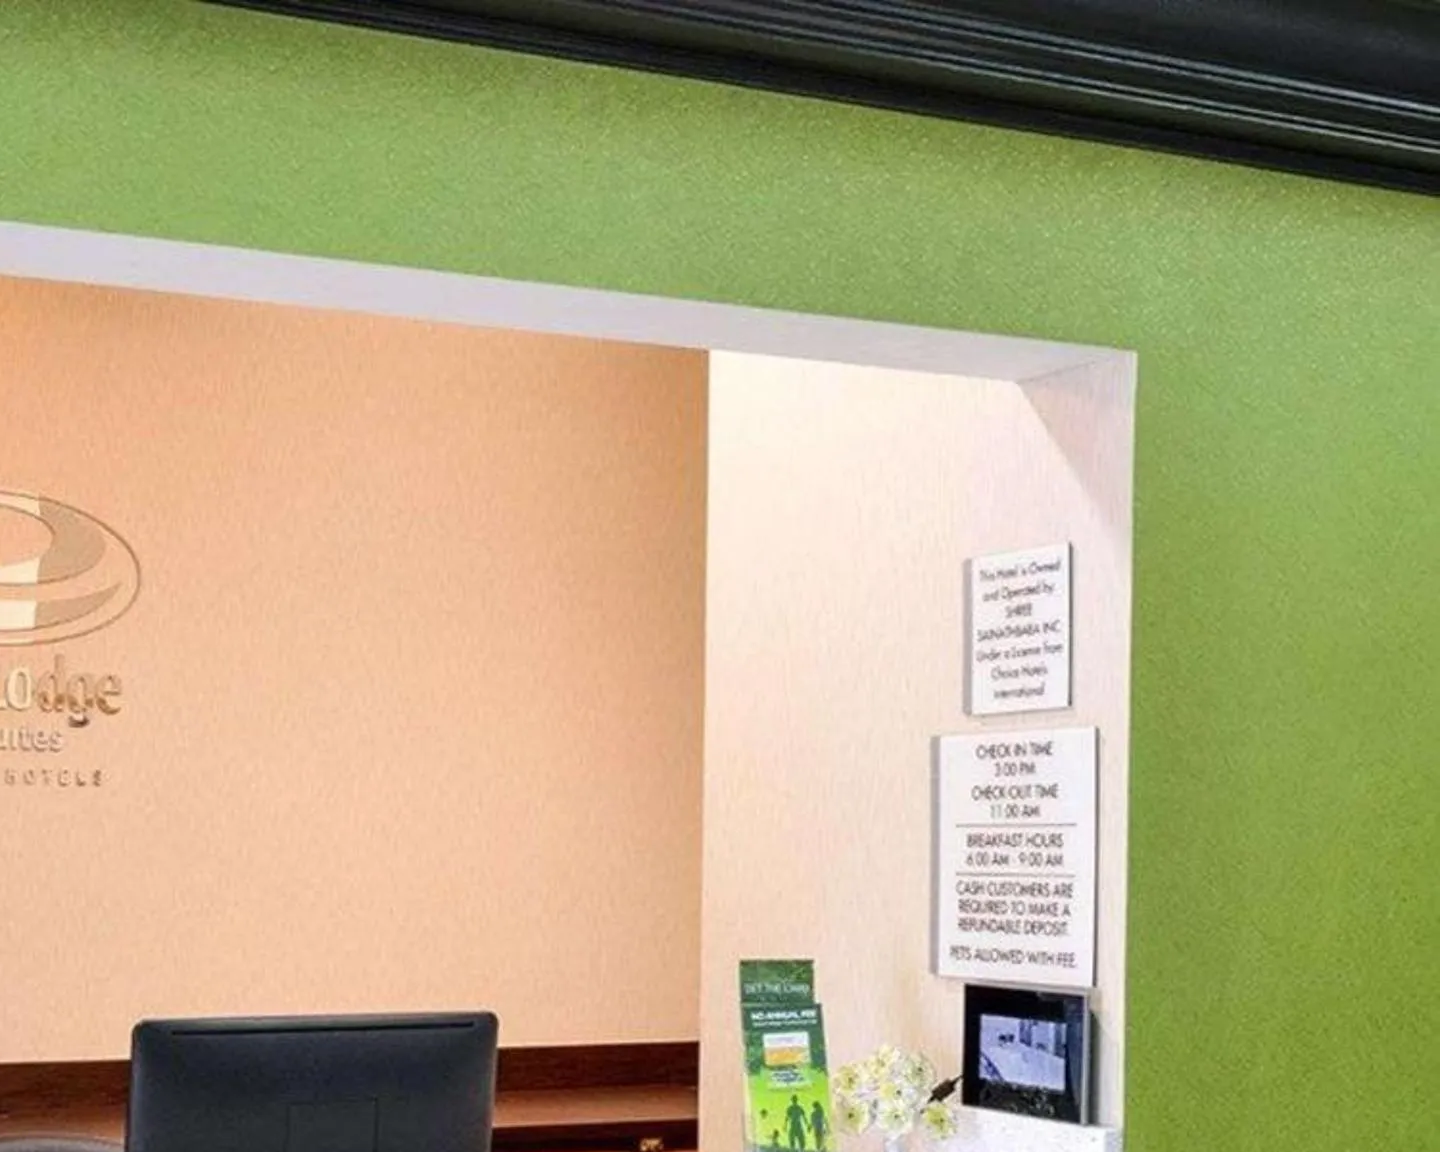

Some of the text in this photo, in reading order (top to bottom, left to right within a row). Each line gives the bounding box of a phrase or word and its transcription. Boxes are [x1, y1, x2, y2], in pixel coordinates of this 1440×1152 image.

[1028, 557, 1061, 575] Owned
[975, 743, 1012, 760] CHECK
[1029, 740, 1053, 756] TIME
[1019, 761, 1037, 775] PM
[971, 783, 1059, 801] CHECK OUT TIME
[1020, 804, 1041, 818] AM
[966, 832, 1064, 849] BREAKFAST HOURS
[955, 880, 1074, 899] CASH CUSTOMERS ARE
[958, 898, 1009, 915] REQUIRED
[1010, 900, 1026, 916] TO
[1028, 901, 1060, 918] MAKE
[958, 917, 1022, 935] REFUNDABLE
[973, 947, 1025, 965] ALLOWED
[1026, 951, 1055, 966] WITH
